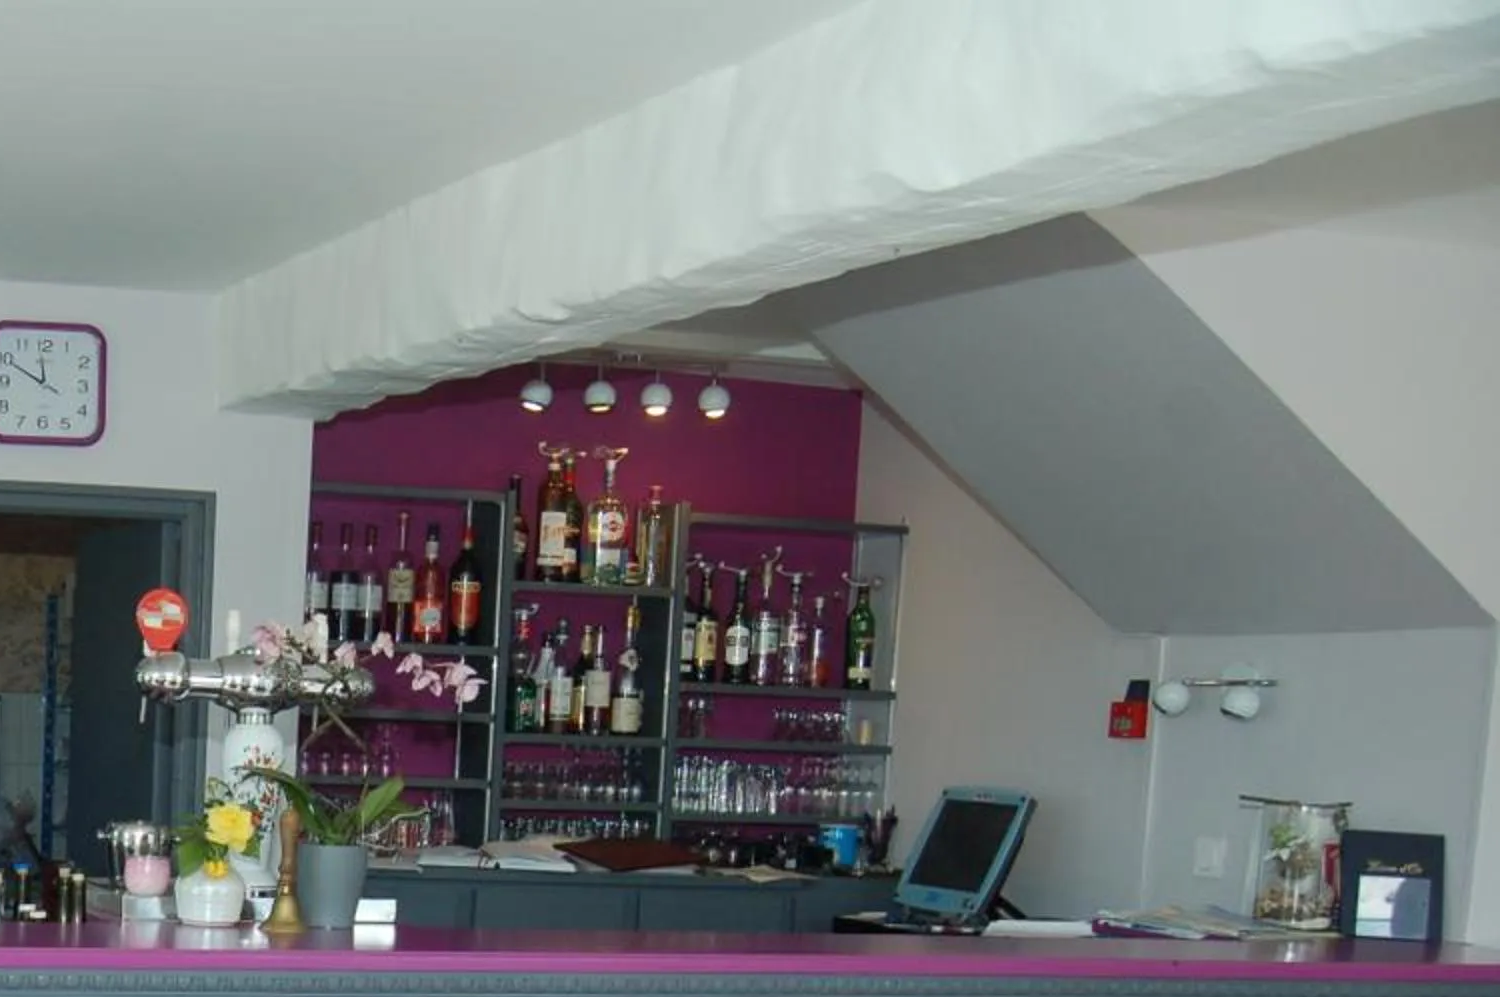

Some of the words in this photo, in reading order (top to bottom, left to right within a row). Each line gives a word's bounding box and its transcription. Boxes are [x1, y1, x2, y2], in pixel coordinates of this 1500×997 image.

[16, 339, 28, 352] 11
[38, 339, 54, 352] 12
[0, 352, 14, 366] 10
[78, 355, 91, 370] 2
[0, 375, 11, 389] 9
[77, 379, 89, 393] 3
[77, 404, 88, 416] 4
[16, 415, 27, 429] 7
[37, 416, 49, 430] 6
[60, 418, 72, 430] 5
